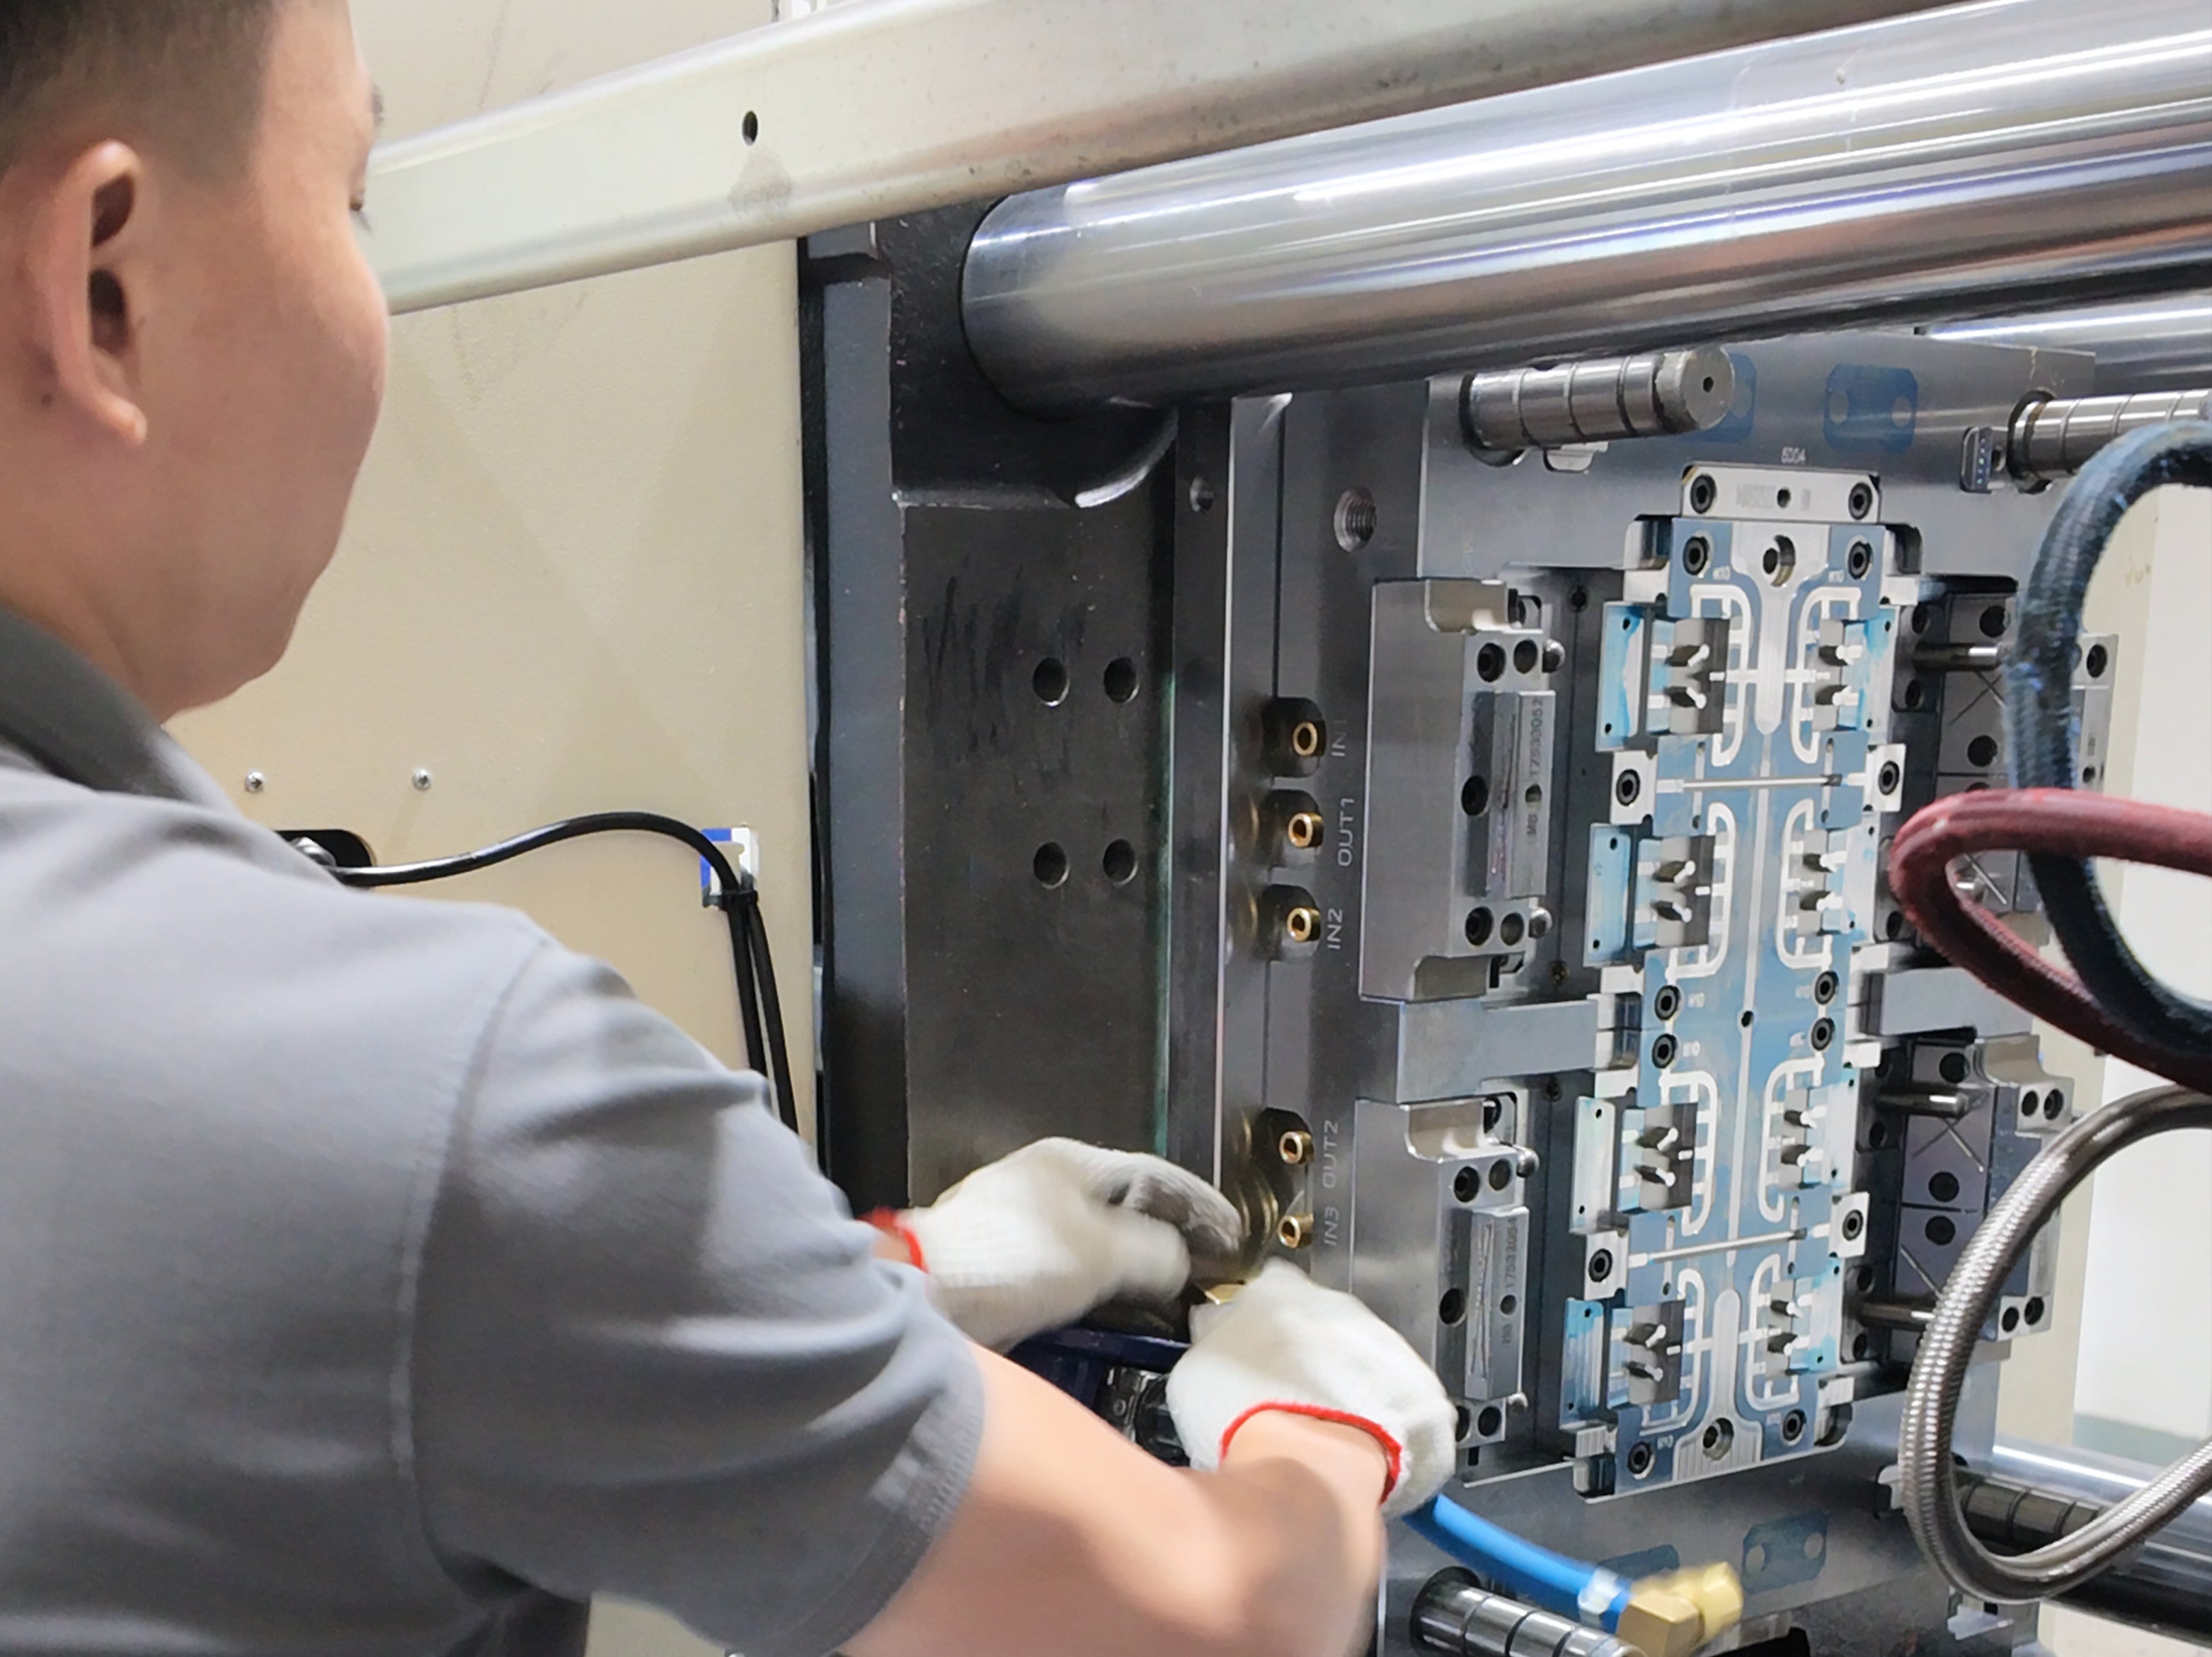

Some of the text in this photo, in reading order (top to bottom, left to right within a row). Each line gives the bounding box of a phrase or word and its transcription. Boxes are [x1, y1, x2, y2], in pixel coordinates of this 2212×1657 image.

[1338, 797, 1355, 866] OUT1
[1327, 908, 1343, 950] IN2
[1322, 1120, 1339, 1188] OUT2
[1324, 1206, 1339, 1246] IN3
